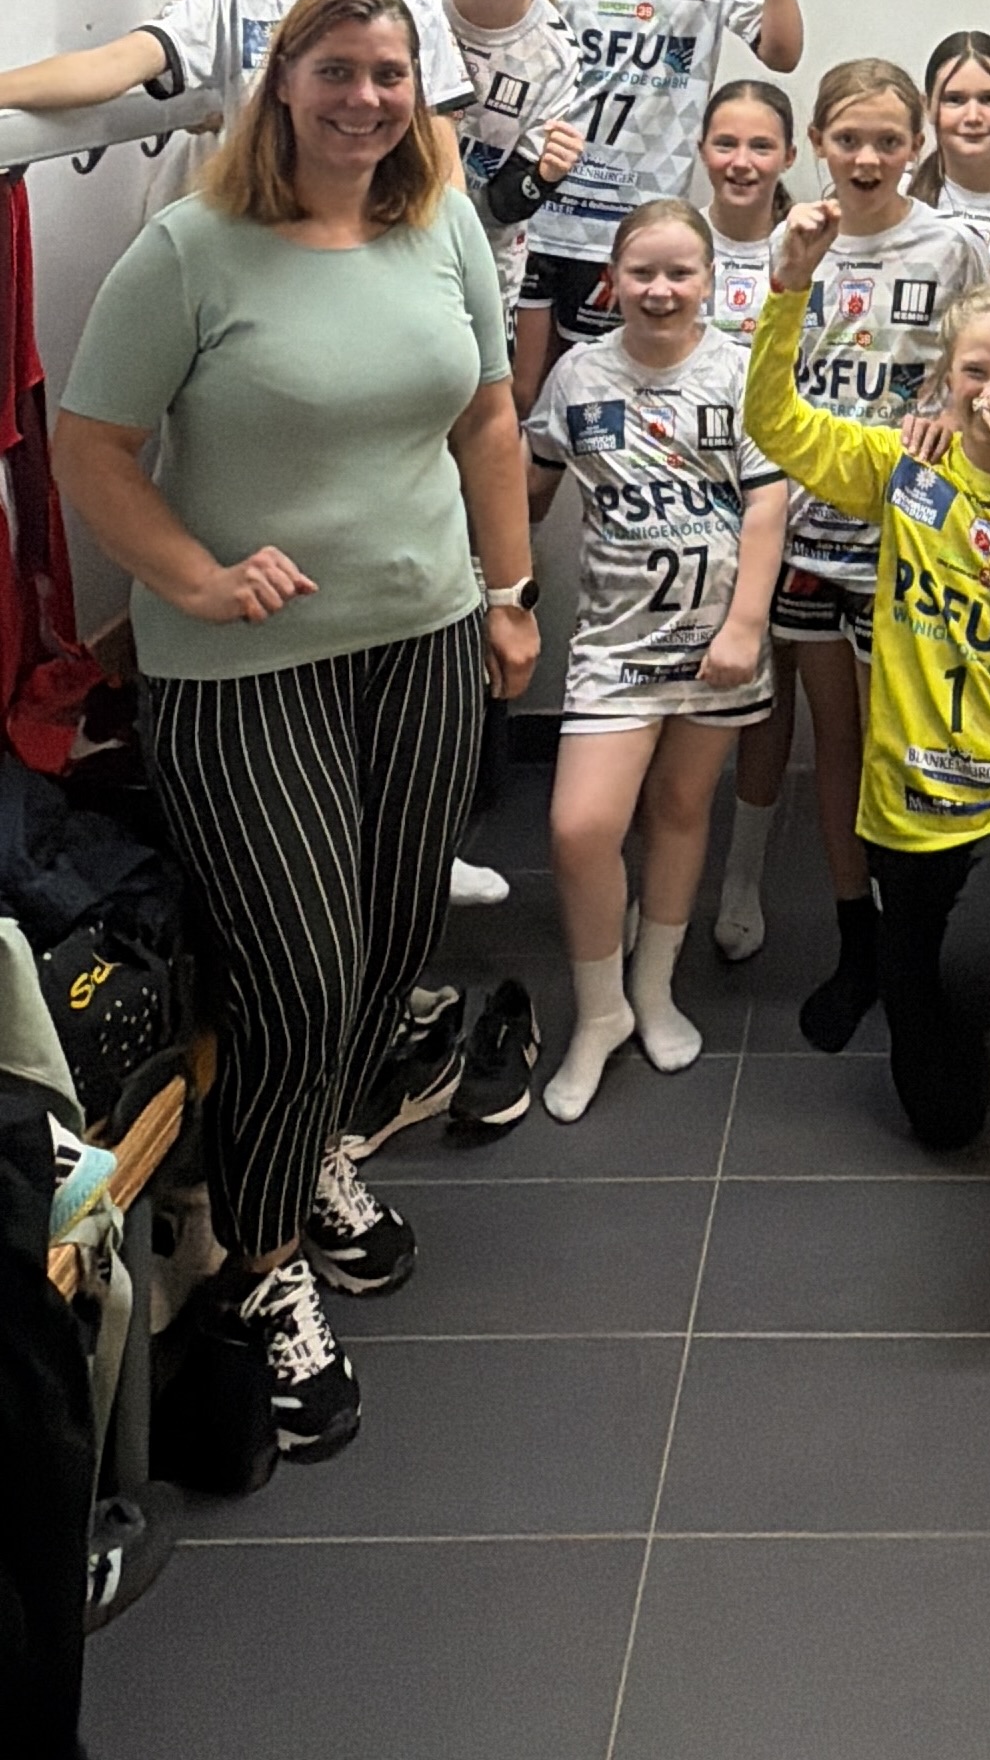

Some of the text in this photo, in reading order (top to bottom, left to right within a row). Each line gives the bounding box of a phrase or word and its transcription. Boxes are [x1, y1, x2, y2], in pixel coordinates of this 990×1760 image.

[580, 29, 666, 71] SFU
[585, 91, 636, 146] 17
[594, 479, 714, 524] PSFU
[646, 545, 709, 613] 27
[944, 665, 967, 733] 1
